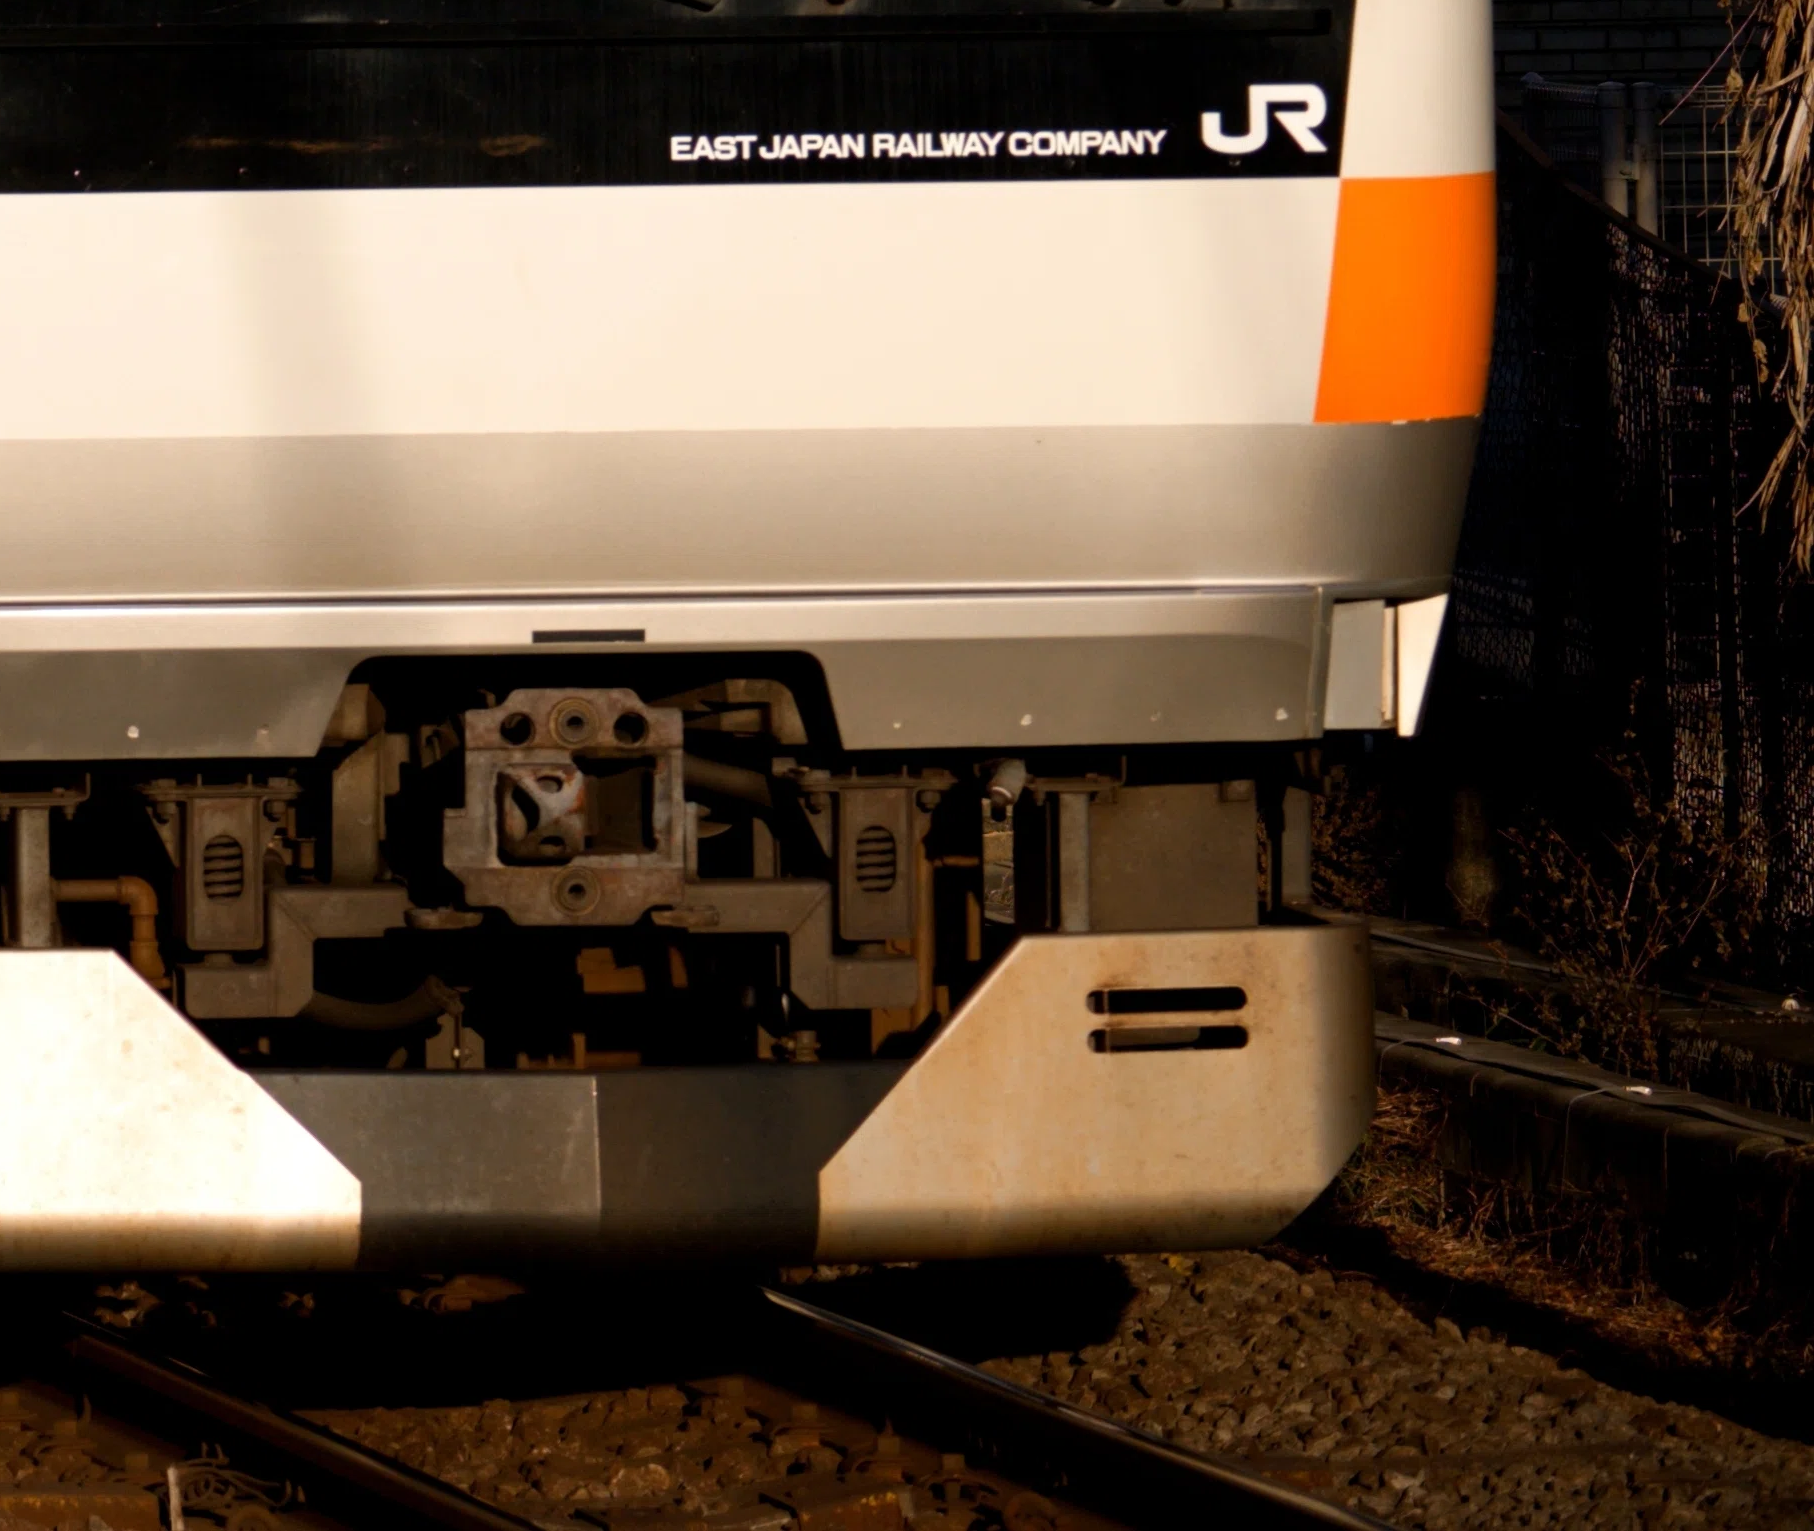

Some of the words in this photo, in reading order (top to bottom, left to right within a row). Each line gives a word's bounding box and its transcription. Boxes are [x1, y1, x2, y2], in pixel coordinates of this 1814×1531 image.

[670, 134, 758, 161] EAST
[759, 133, 866, 160] JAPAN
[872, 131, 1005, 158] RAILWAY
[1007, 129, 1167, 157] COMPANY
[1201, 83, 1328, 155] JR
